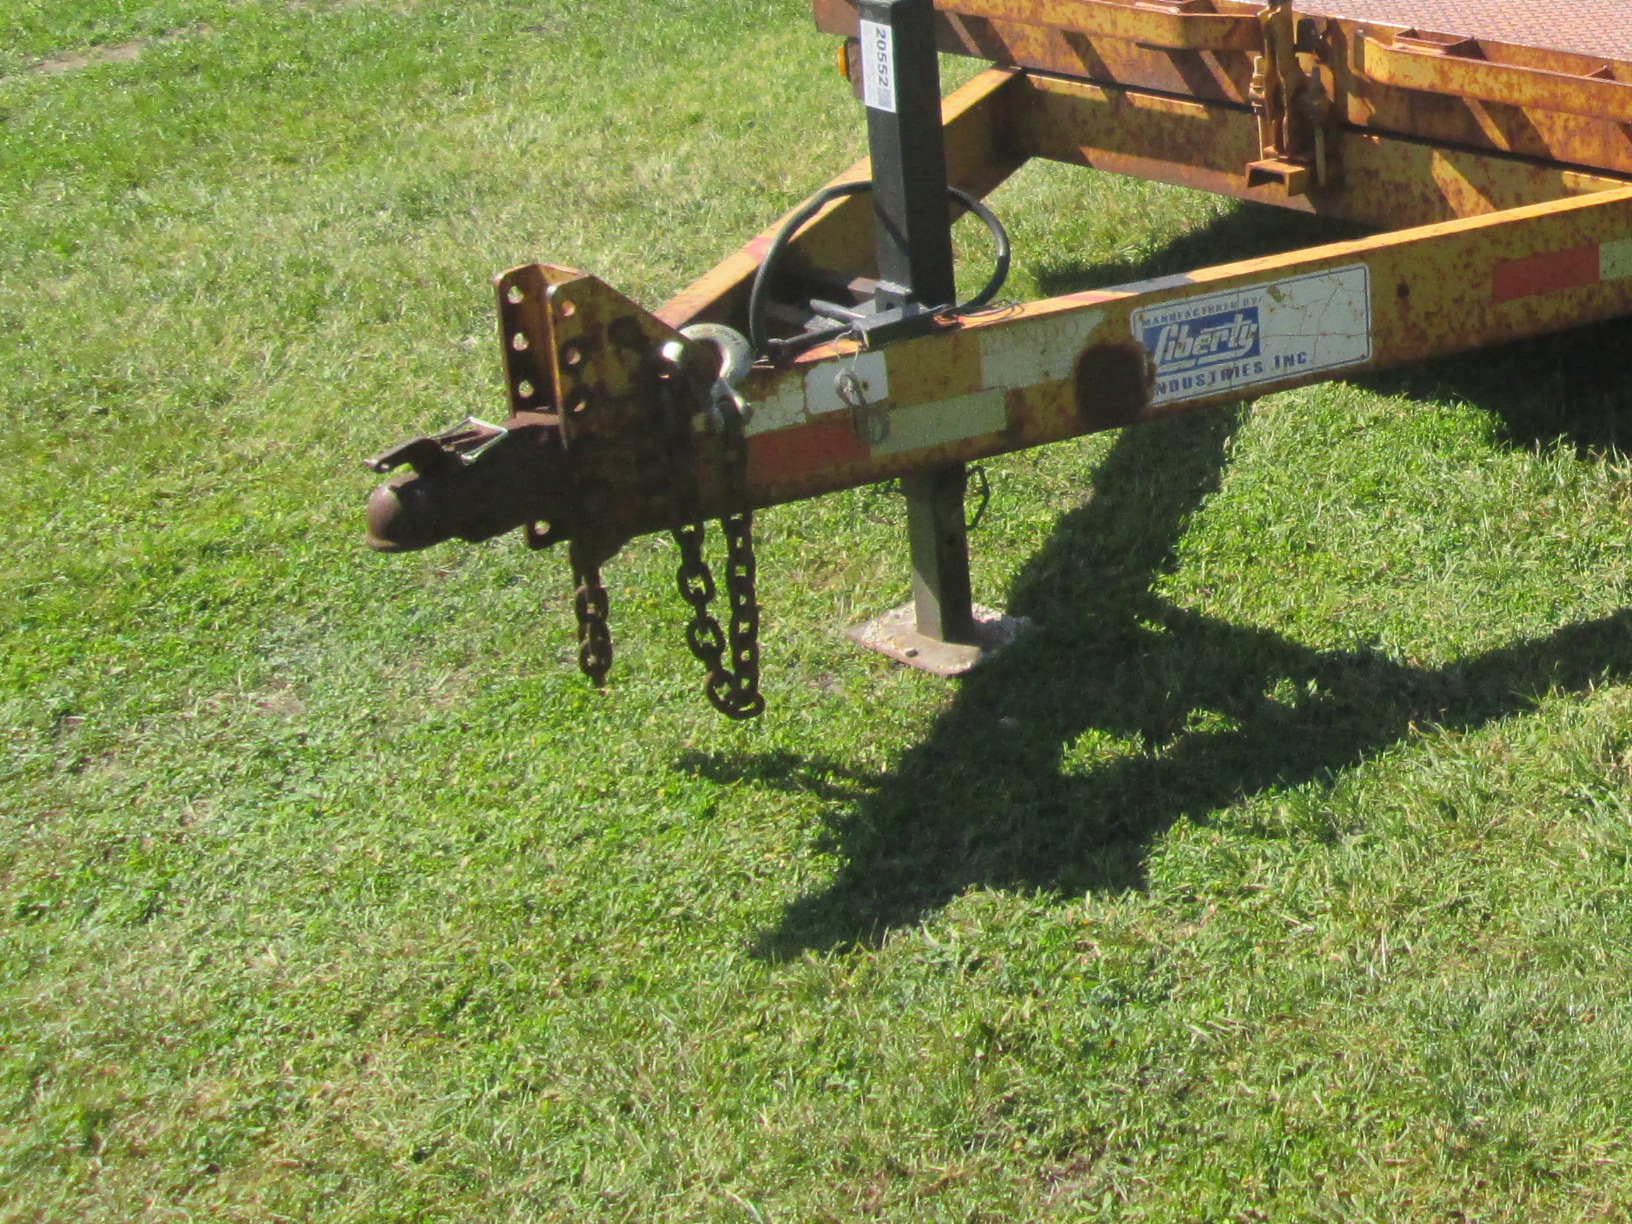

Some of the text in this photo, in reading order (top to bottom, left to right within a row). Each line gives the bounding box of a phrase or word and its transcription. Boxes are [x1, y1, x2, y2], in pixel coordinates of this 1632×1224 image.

[875, 26, 890, 88] 20552
[1153, 313, 1259, 373] Liberty
[1155, 350, 1308, 395] NDUSTRIES INC
